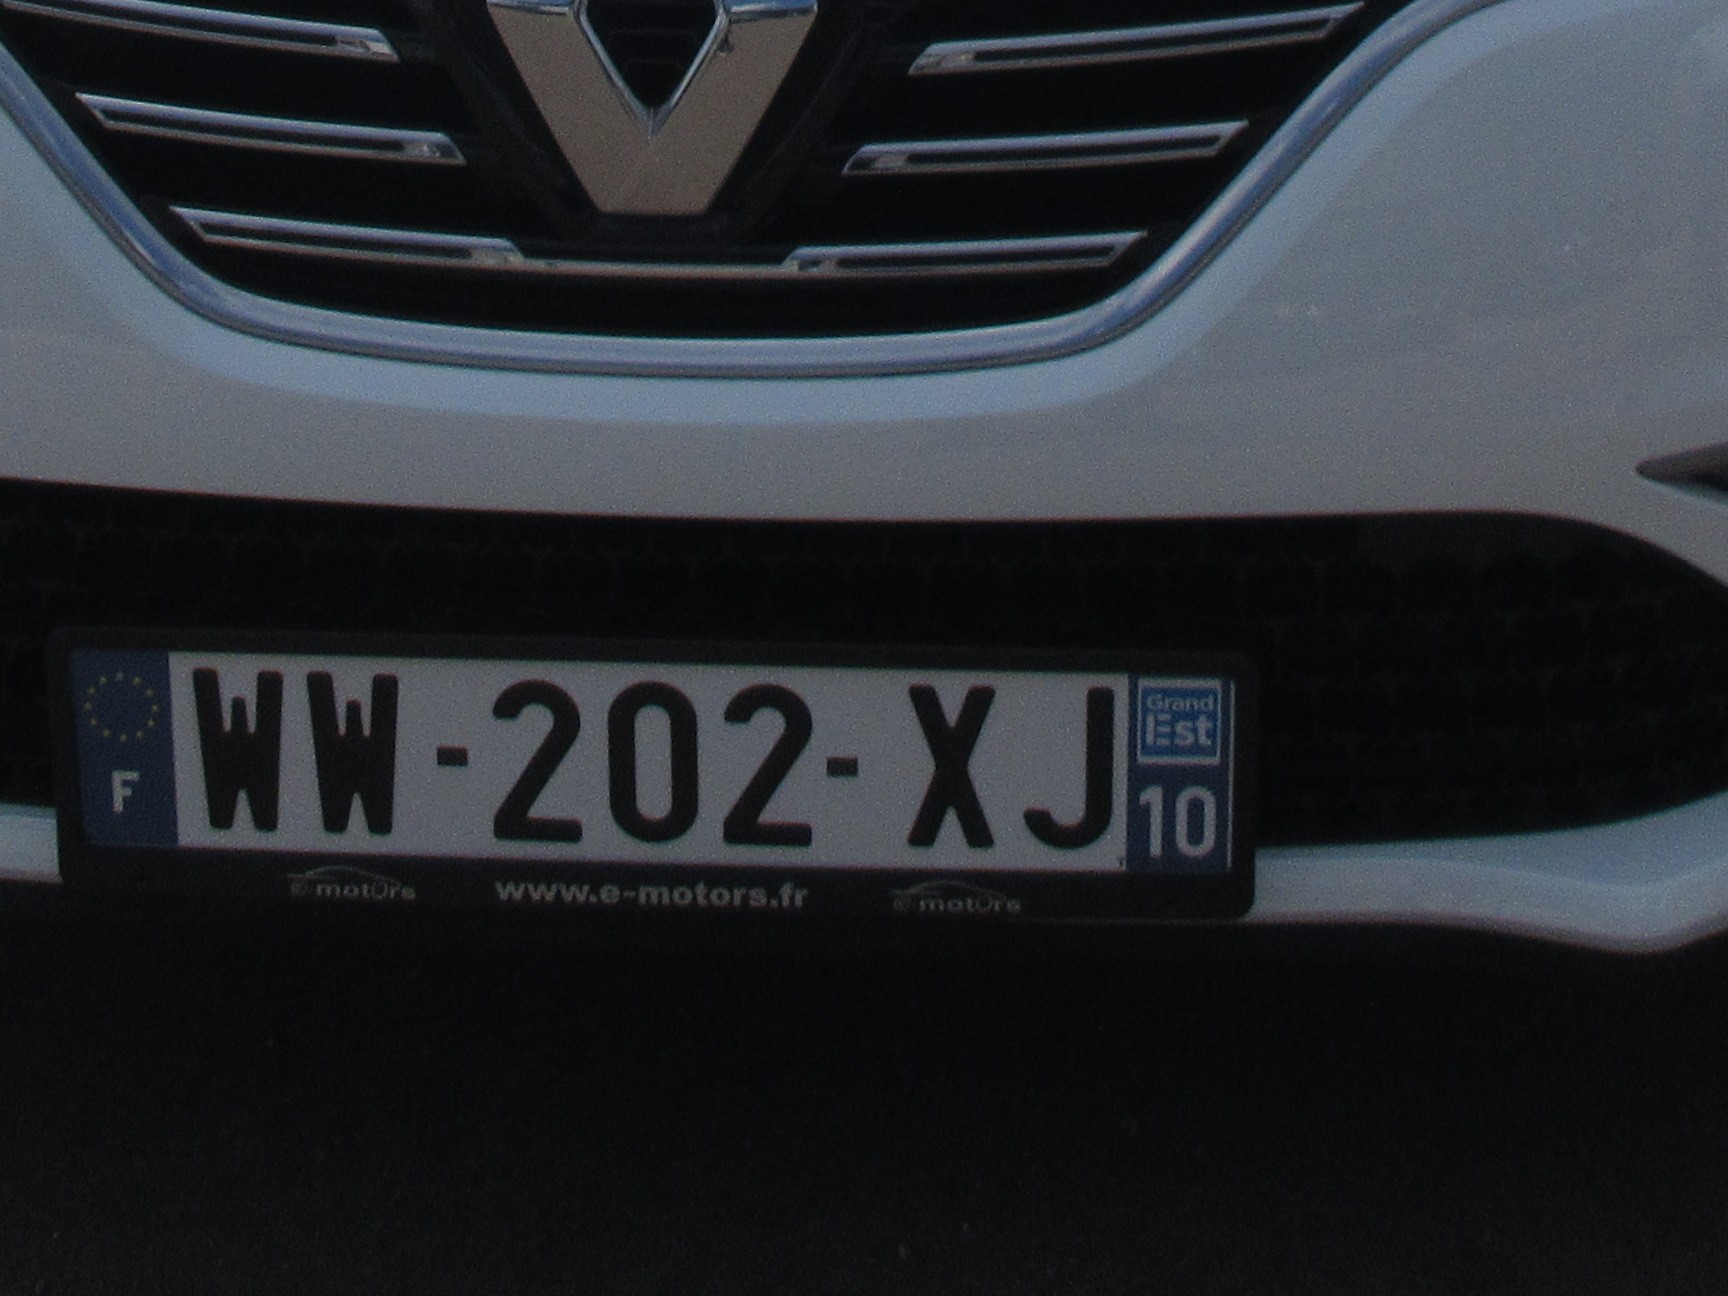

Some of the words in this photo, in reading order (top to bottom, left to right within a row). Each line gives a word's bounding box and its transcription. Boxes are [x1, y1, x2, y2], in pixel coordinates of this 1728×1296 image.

[1146, 690, 1216, 713] Grand
[1144, 713, 1214, 748] Est
[192, 666, 1115, 849] WW-202-XJ
[111, 770, 141, 815] F
[1138, 785, 1218, 858] 10
[495, 878, 810, 910] www.e-motors.fr
